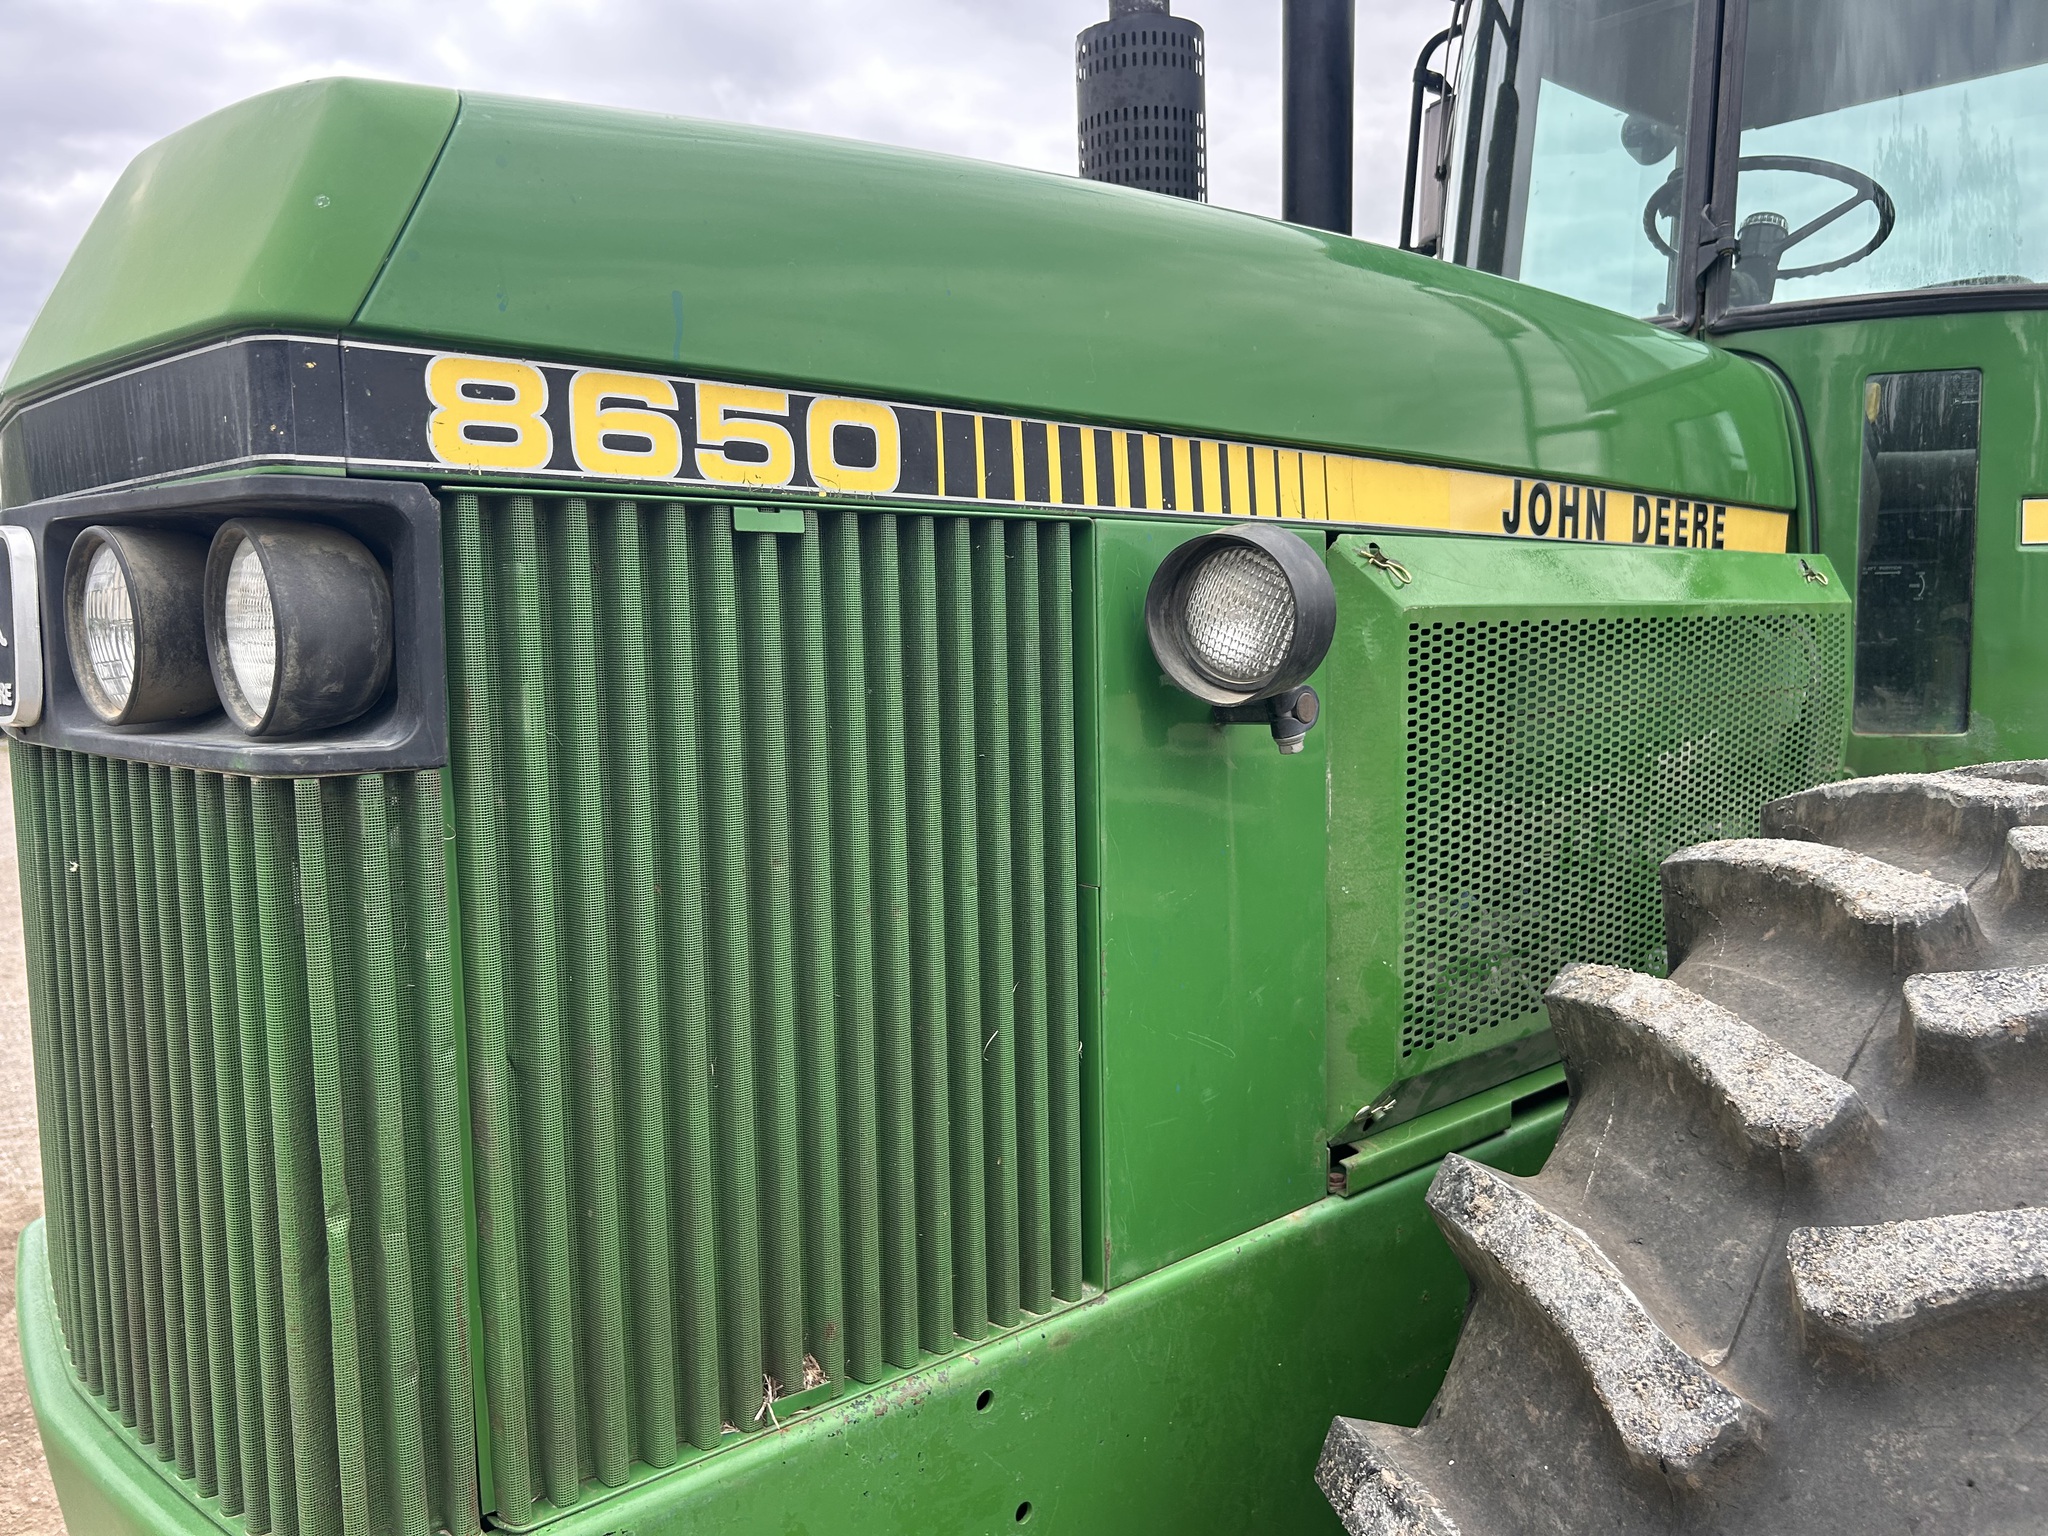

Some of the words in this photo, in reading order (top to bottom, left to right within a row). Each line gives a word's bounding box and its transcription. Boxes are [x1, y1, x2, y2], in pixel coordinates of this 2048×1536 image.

[425, 354, 902, 493] 8650
[1502, 479, 1606, 541] JOHN
[1632, 495, 1726, 550] DEERE
